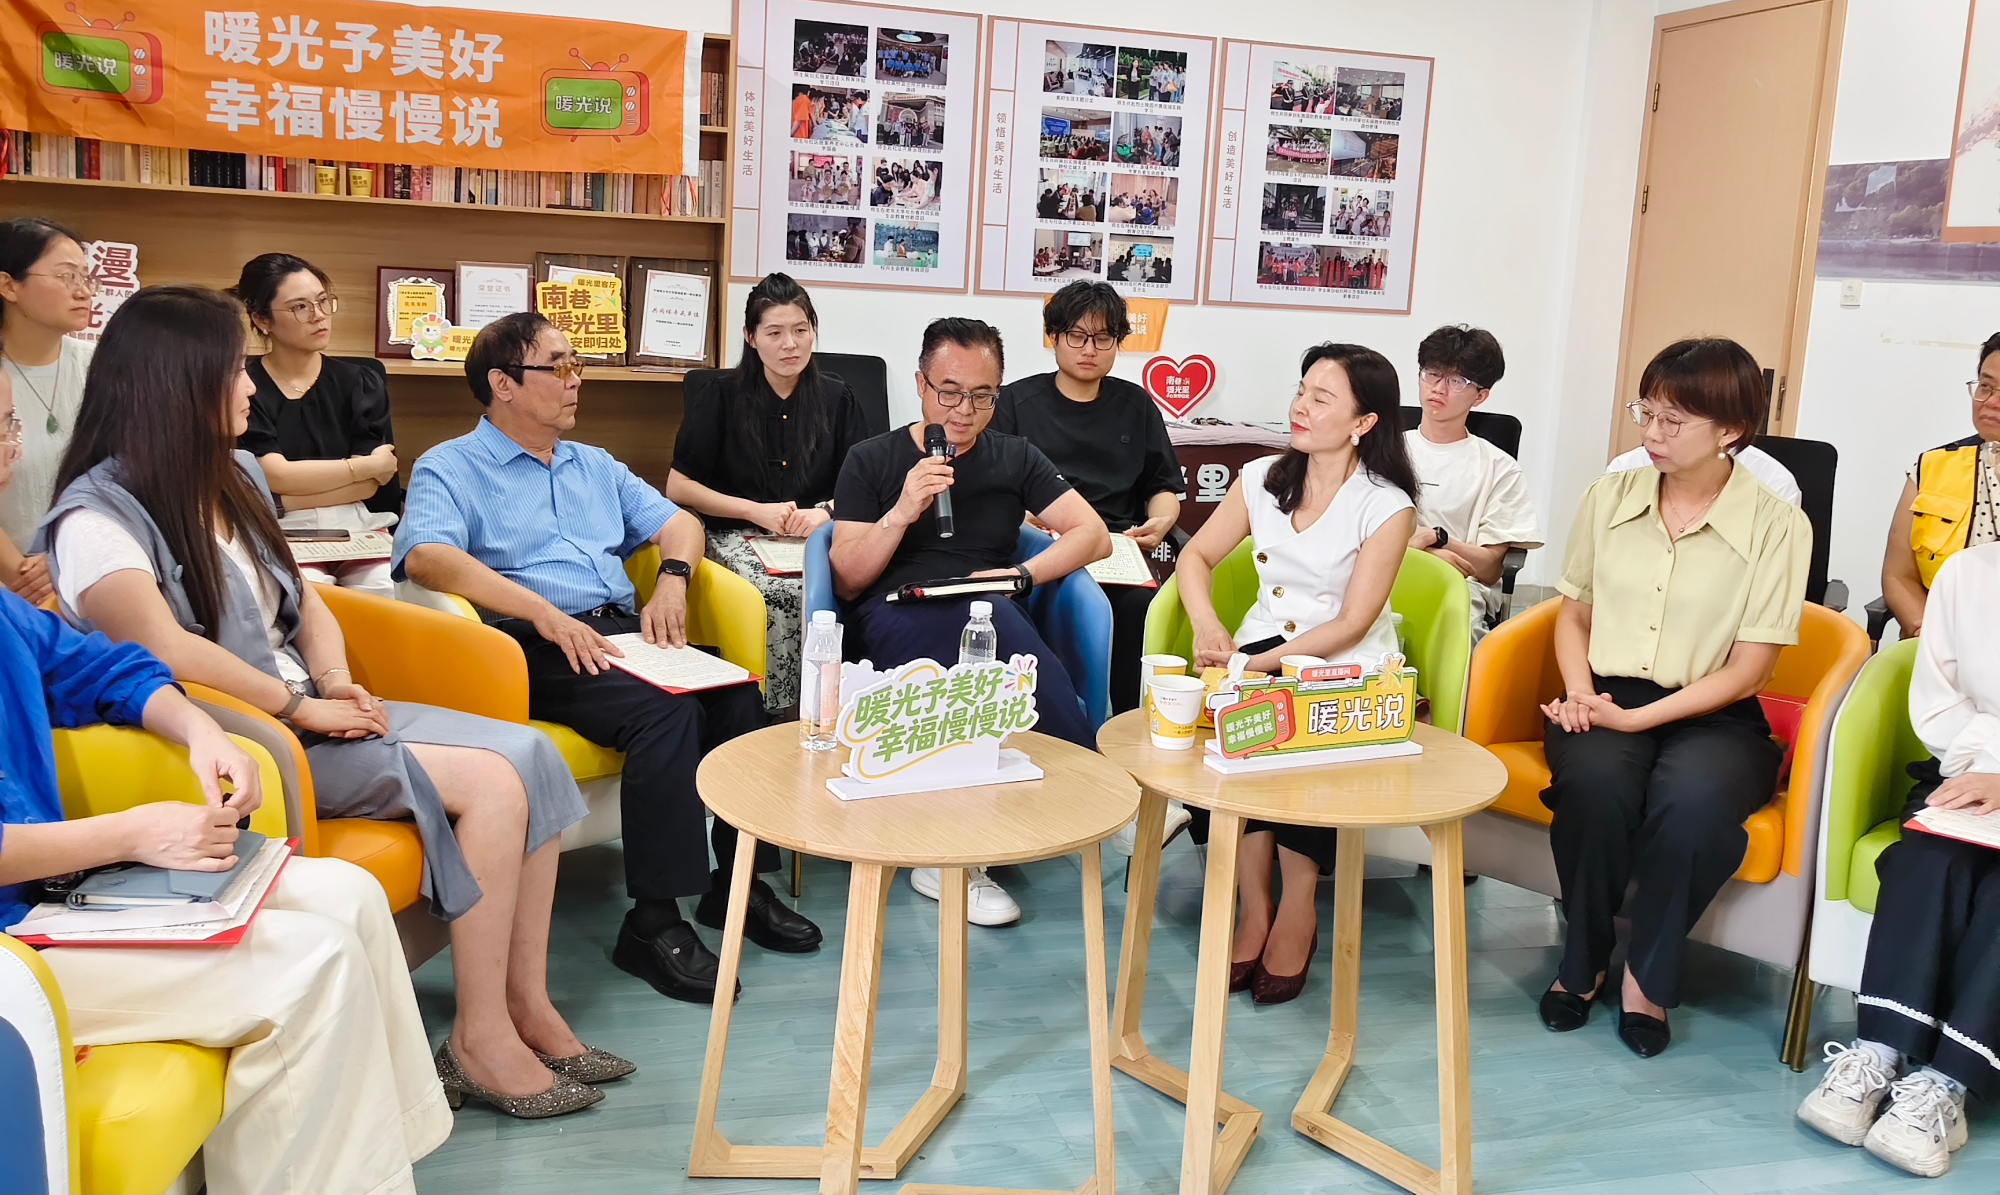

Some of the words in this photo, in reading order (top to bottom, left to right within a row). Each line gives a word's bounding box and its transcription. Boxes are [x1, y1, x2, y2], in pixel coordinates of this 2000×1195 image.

[204, 11, 504, 83] 暖光予美好
[54, 51, 118, 77] 暖光说
[205, 78, 503, 149] 幸福慢慢说
[555, 95, 613, 115] 暖光说
[742, 90, 755, 176] 体验美好生活
[992, 112, 1007, 194] 领悟美好生活
[1222, 131, 1237, 209] 创造美好生活
[84, 244, 132, 281] 漫
[477, 284, 511, 293] 荣誉证书
[541, 284, 592, 310] 南巷
[577, 279, 617, 289] 暖光里客厅
[548, 310, 620, 335] 暖光里
[570, 336, 622, 349] 安即归处
[1311, 667, 1351, 678] 暖光里直播间
[854, 667, 1003, 735] 暖光予美好
[1225, 709, 1272, 733] 暖光予美好
[1307, 693, 1405, 736] 暖光说
[872, 693, 1035, 763] 幸福慢慢说
[1227, 721, 1274, 746] 幸福慢慢说
